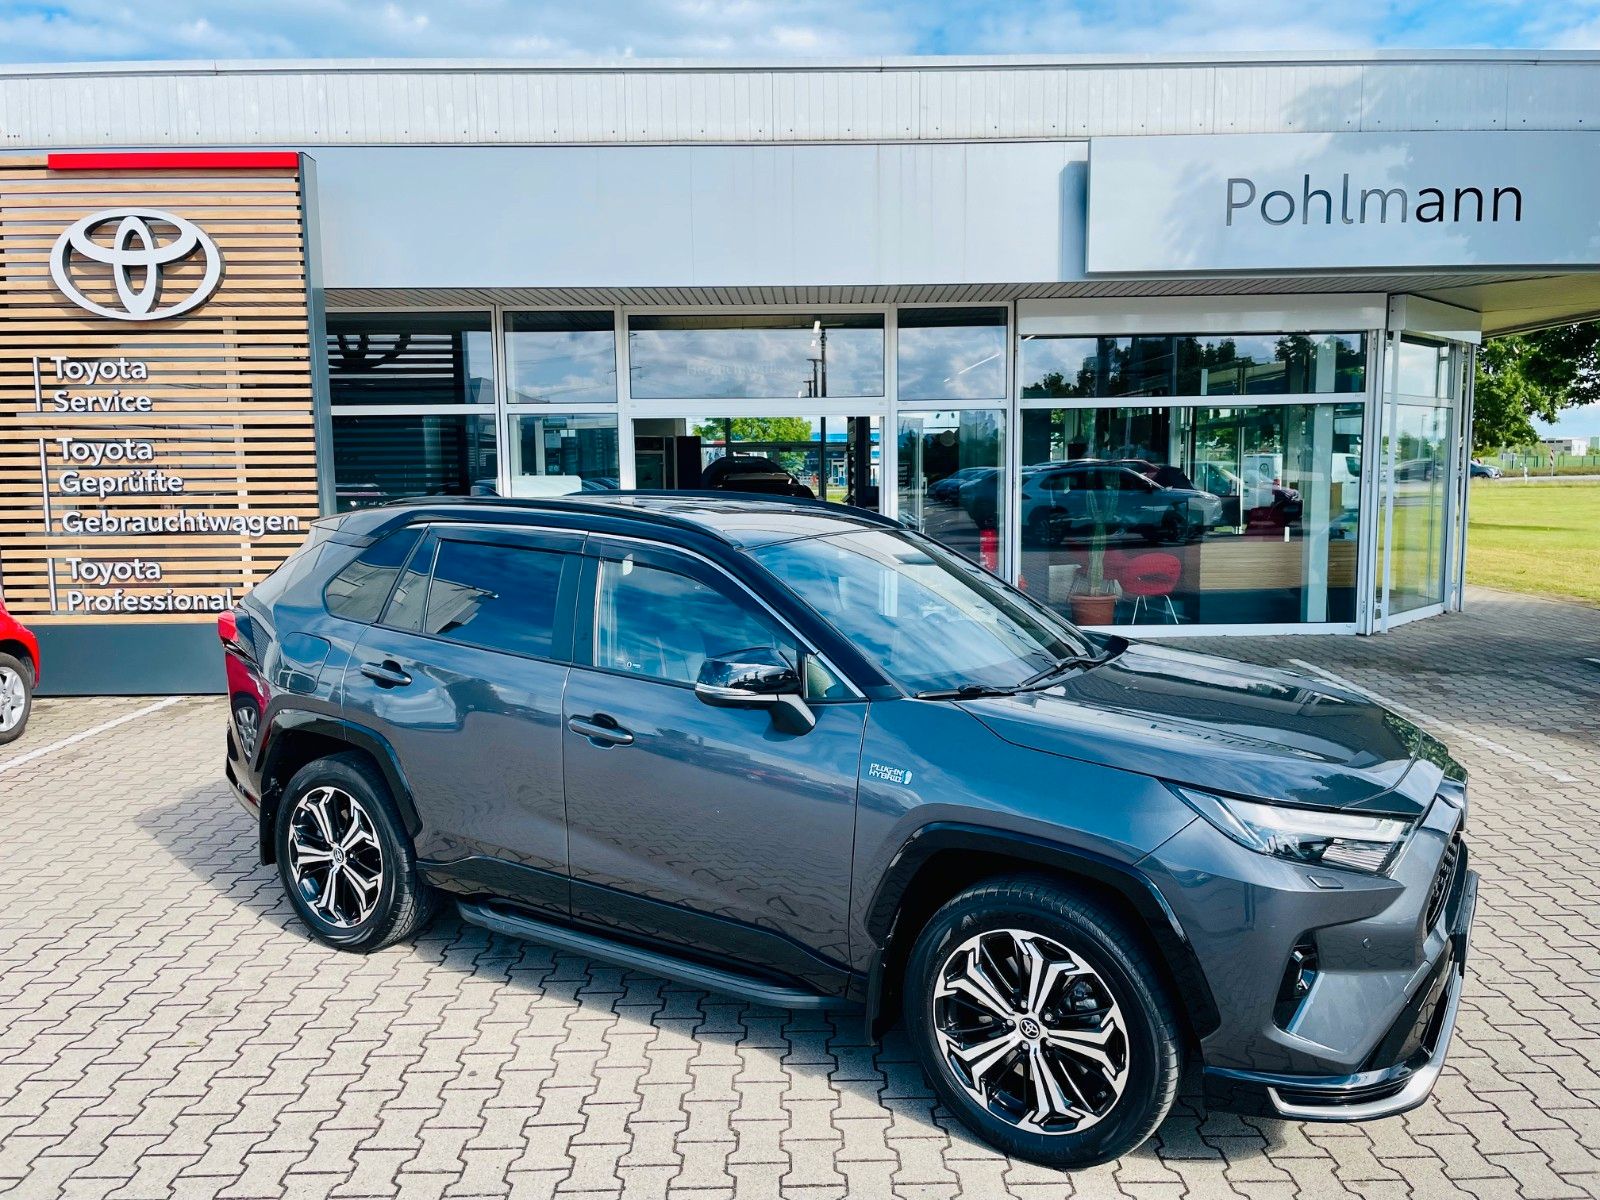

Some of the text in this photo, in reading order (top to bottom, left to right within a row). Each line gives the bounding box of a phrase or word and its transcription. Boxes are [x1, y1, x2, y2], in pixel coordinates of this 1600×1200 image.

[1226, 173, 1522, 226] Pohlmann
[51, 356, 148, 385] Toyota
[54, 390, 152, 413] Service
[57, 437, 154, 466] Toyota
[59, 470, 184, 499] Geprüfte
[62, 510, 300, 537] Gebrauchtwagen
[66, 557, 162, 585] Toyota
[67, 587, 235, 611] Professional
